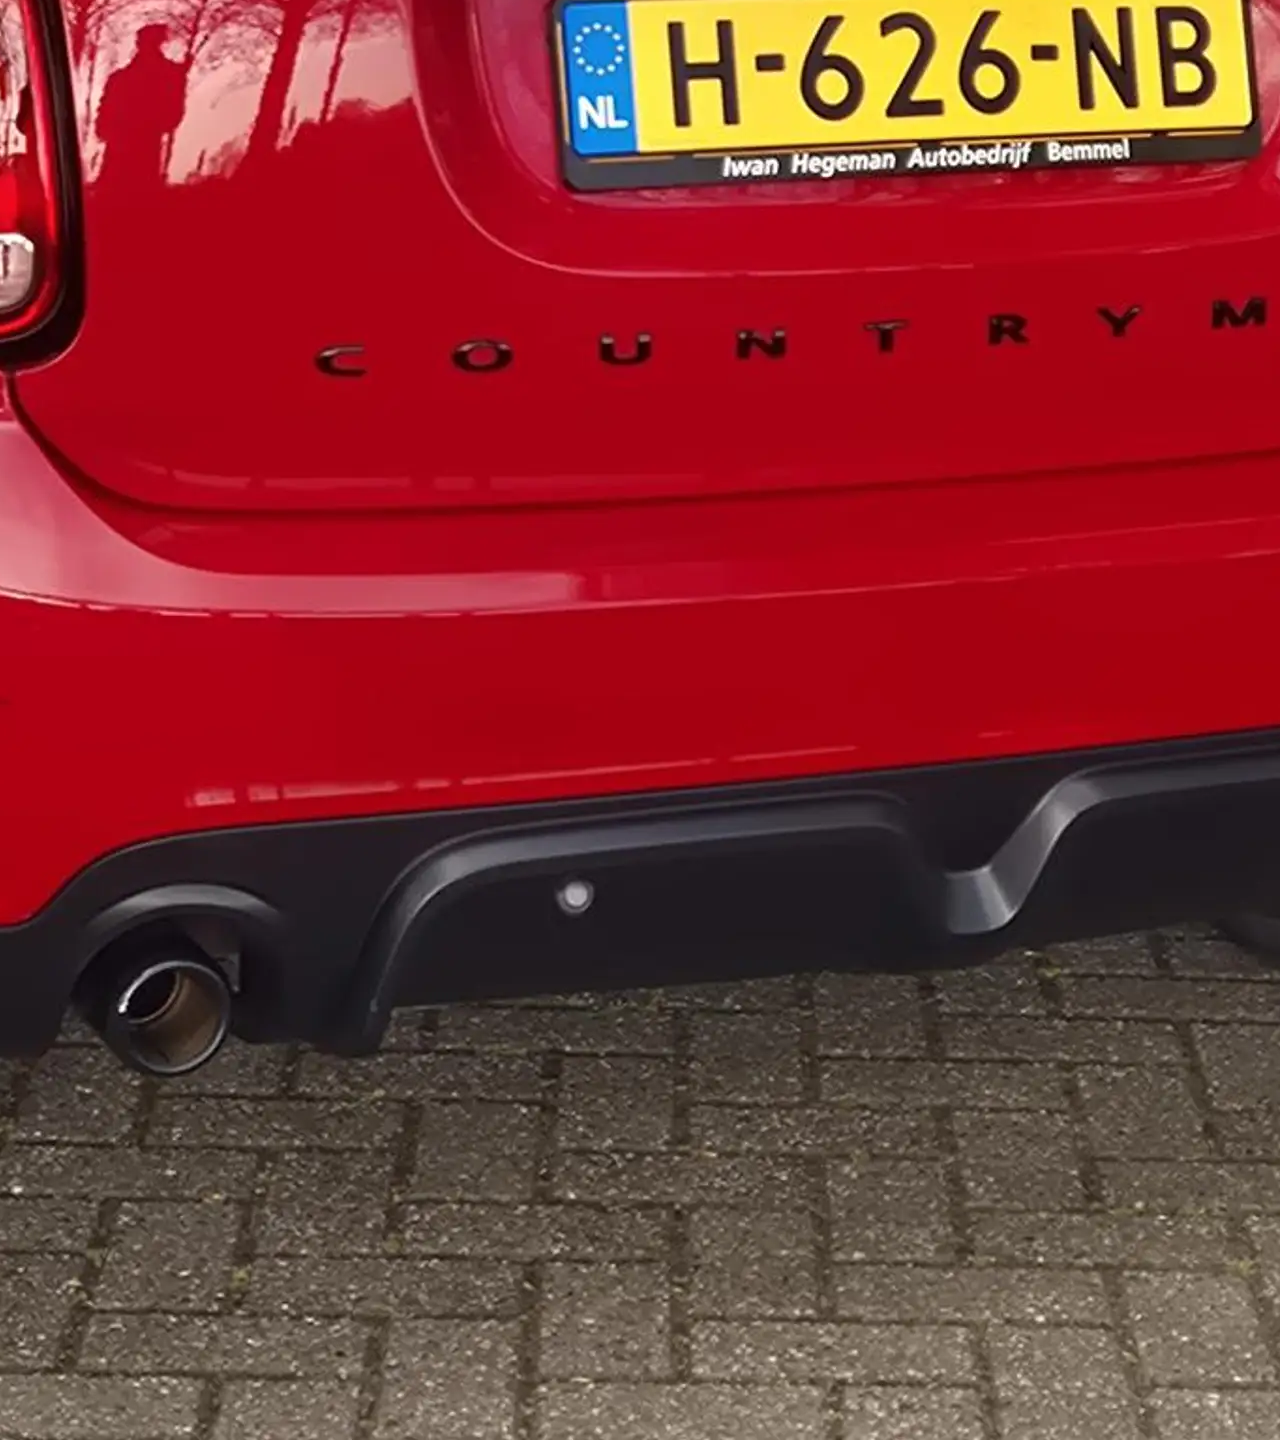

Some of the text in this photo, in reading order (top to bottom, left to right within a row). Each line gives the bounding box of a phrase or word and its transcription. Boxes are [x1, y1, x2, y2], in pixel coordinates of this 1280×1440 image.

[667, 5, 1217, 127] H-626-NB
[577, 94, 629, 130] NL
[722, 137, 1130, 178] Iwan Hegeman Autobedrijf Bemmel
